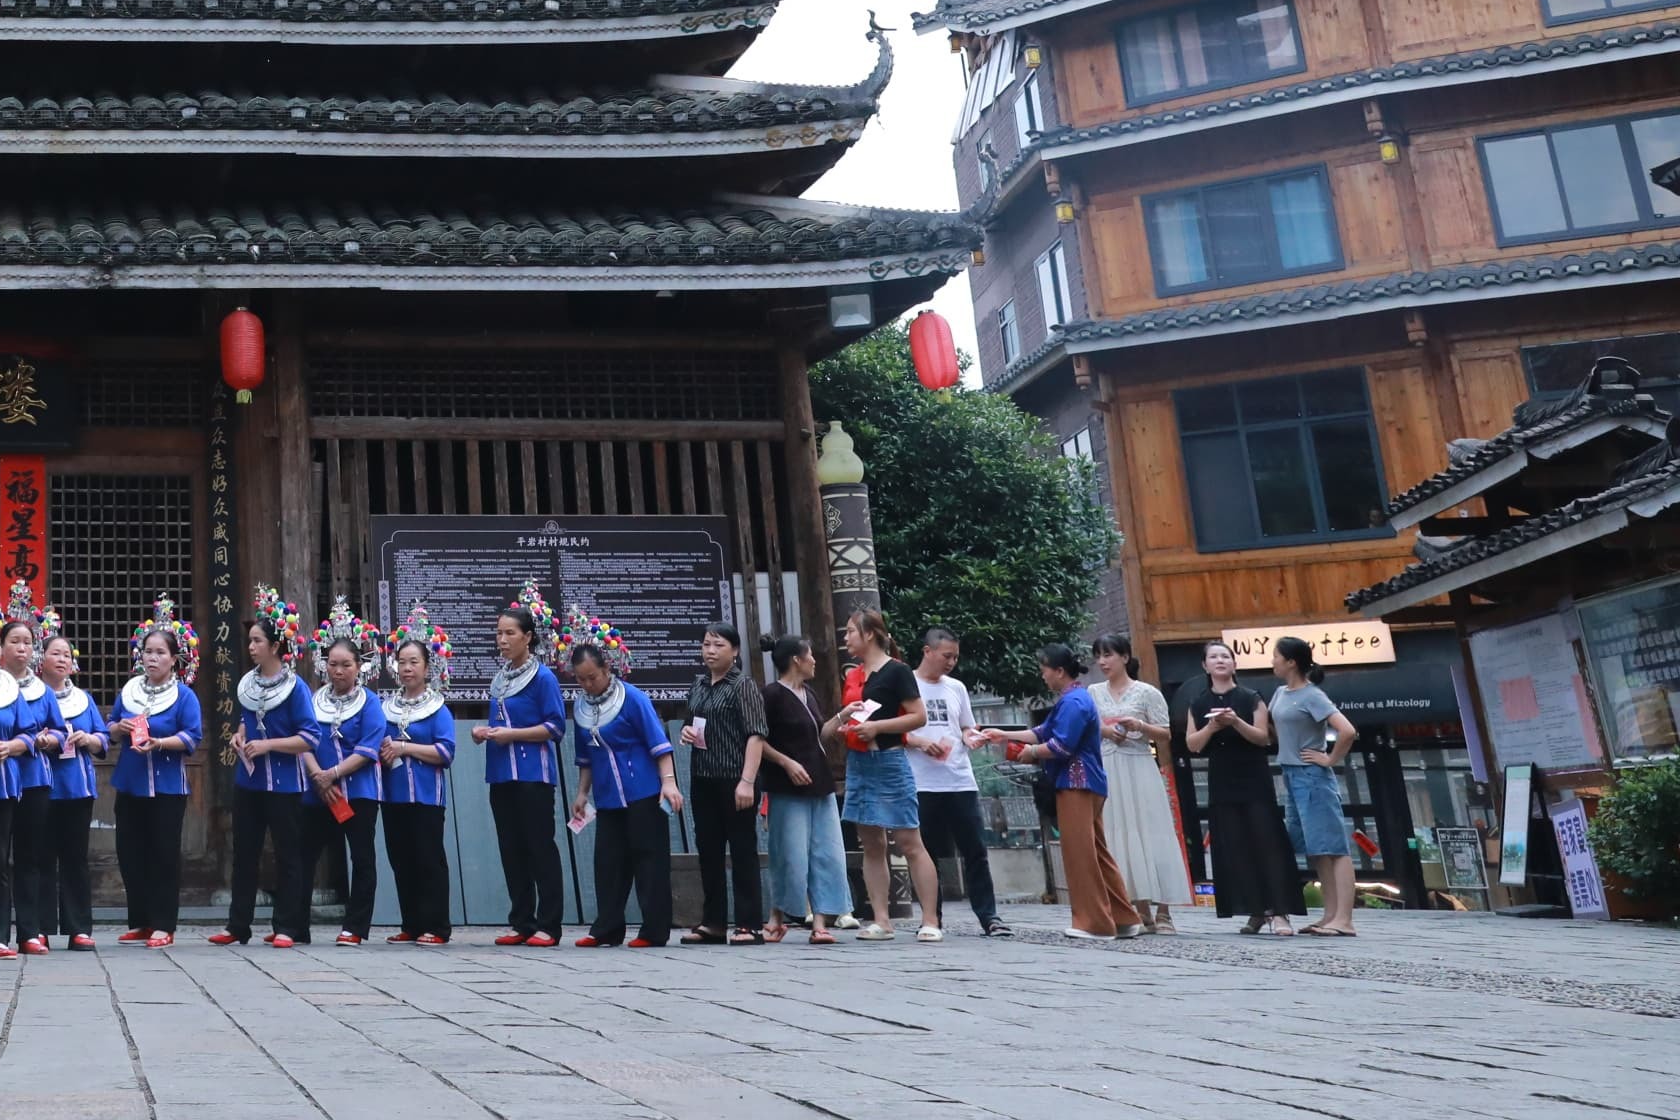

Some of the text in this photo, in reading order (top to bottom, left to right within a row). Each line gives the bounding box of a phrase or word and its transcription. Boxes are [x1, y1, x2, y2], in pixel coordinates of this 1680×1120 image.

[516, 536, 590, 547] 平岩村村规民约
[1233, 631, 1382, 656] WY ffee
[1340, 701, 1364, 710] Juice
[1386, 699, 1431, 708] Mixology
